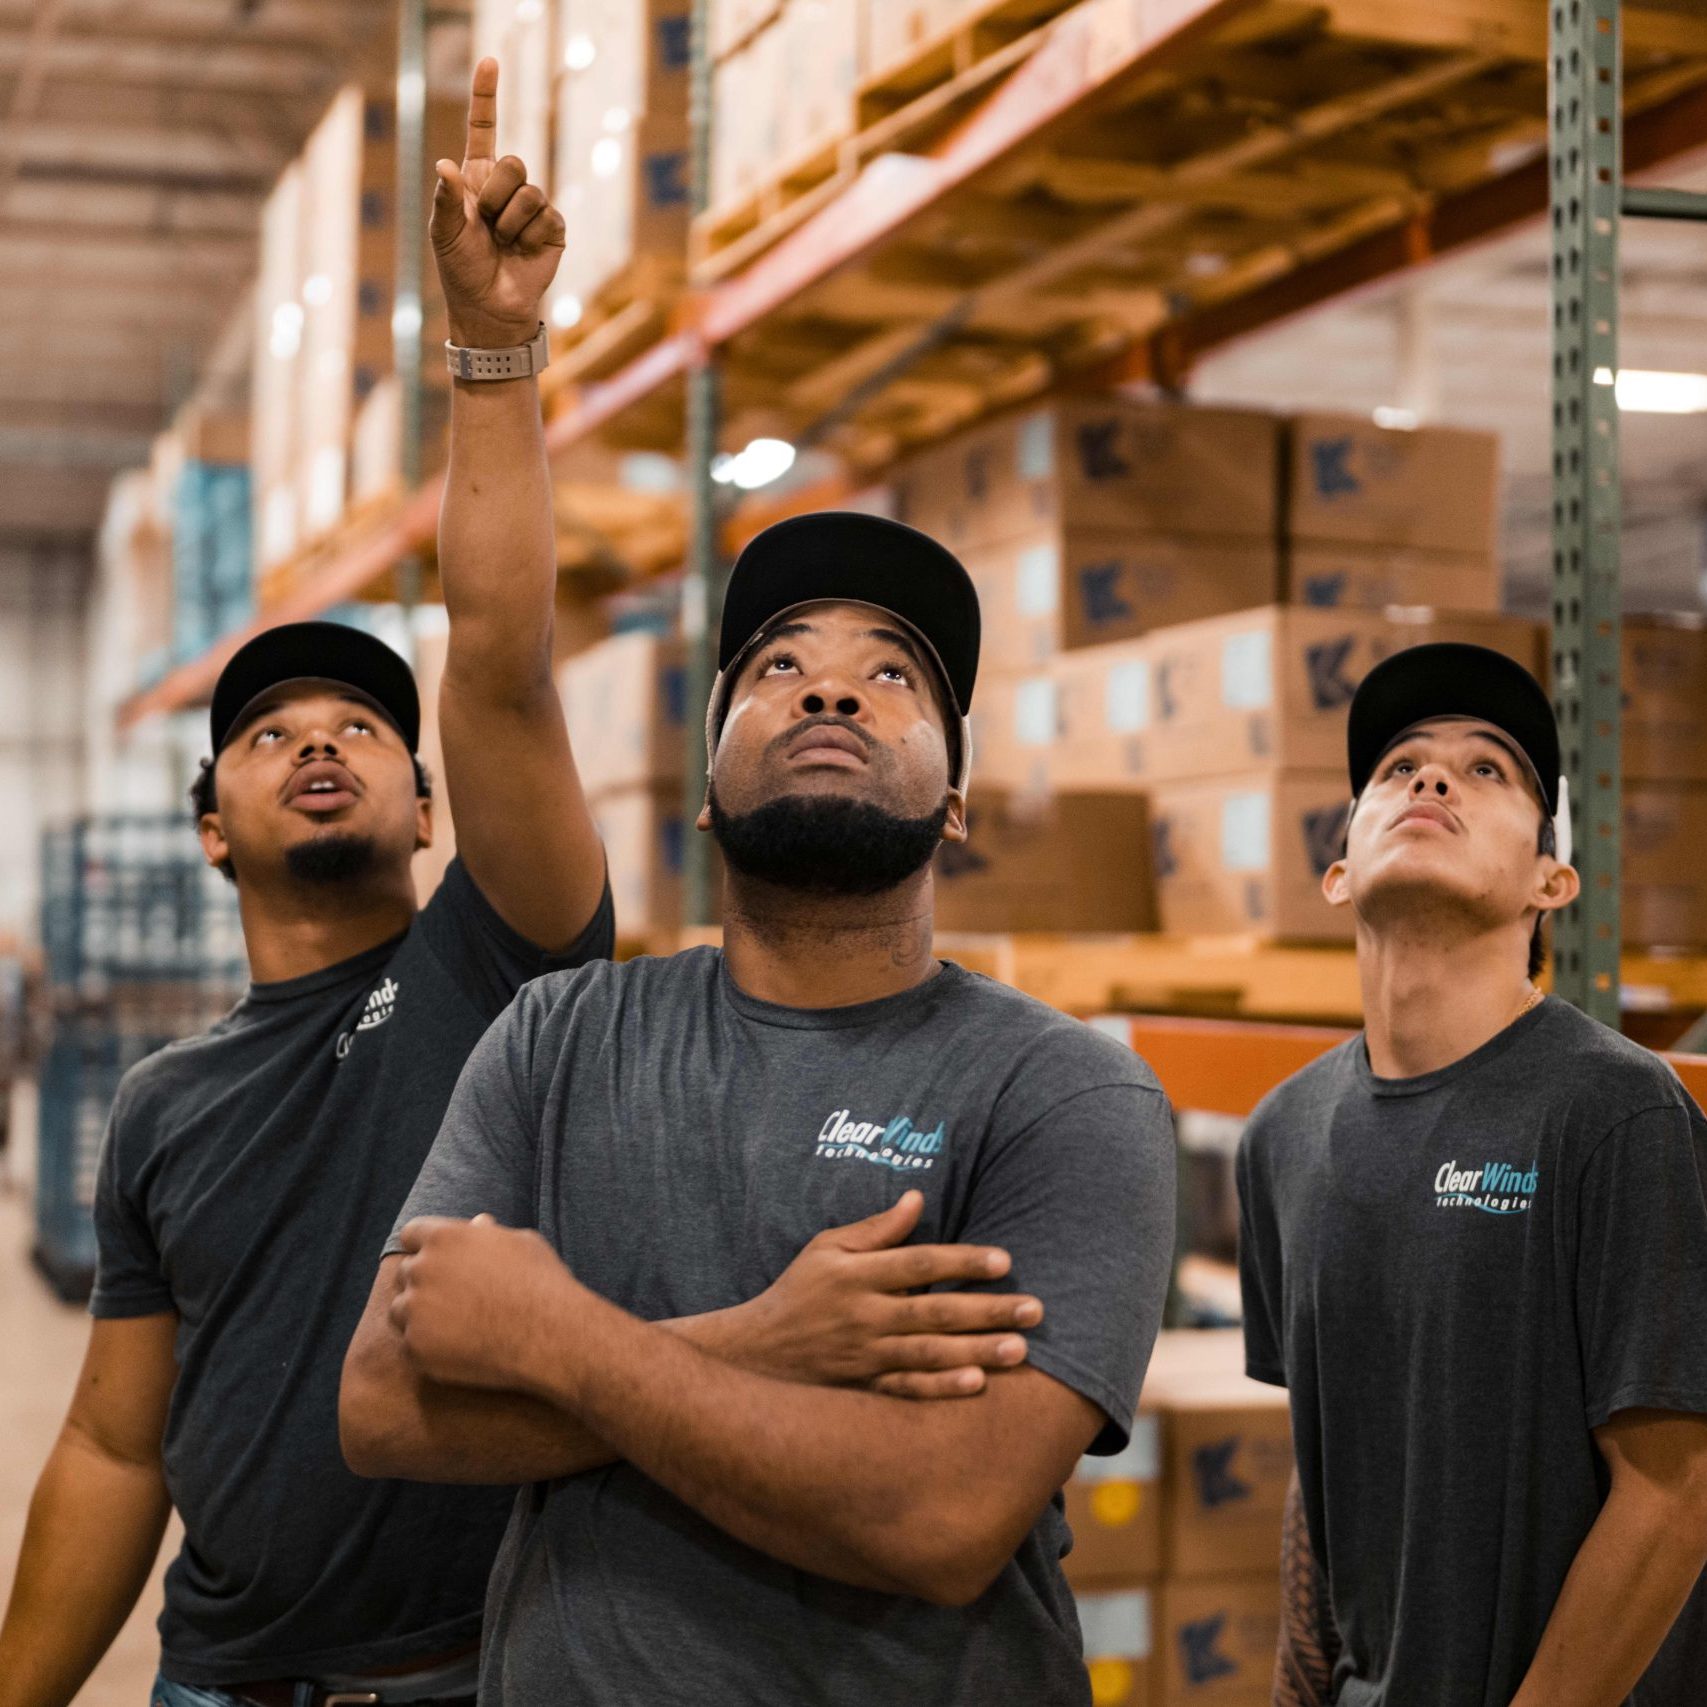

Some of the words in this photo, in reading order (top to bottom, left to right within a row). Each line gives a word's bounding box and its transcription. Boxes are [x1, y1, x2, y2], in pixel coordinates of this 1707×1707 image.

[1078, 410, 1129, 479] K
[1312, 436, 1361, 496] K
[1080, 560, 1132, 625] K
[1305, 635, 1359, 709] K
[815, 1144, 934, 1169] technoogies
[1194, 1436, 1251, 1506] K
[1179, 1614, 1238, 1685] K
